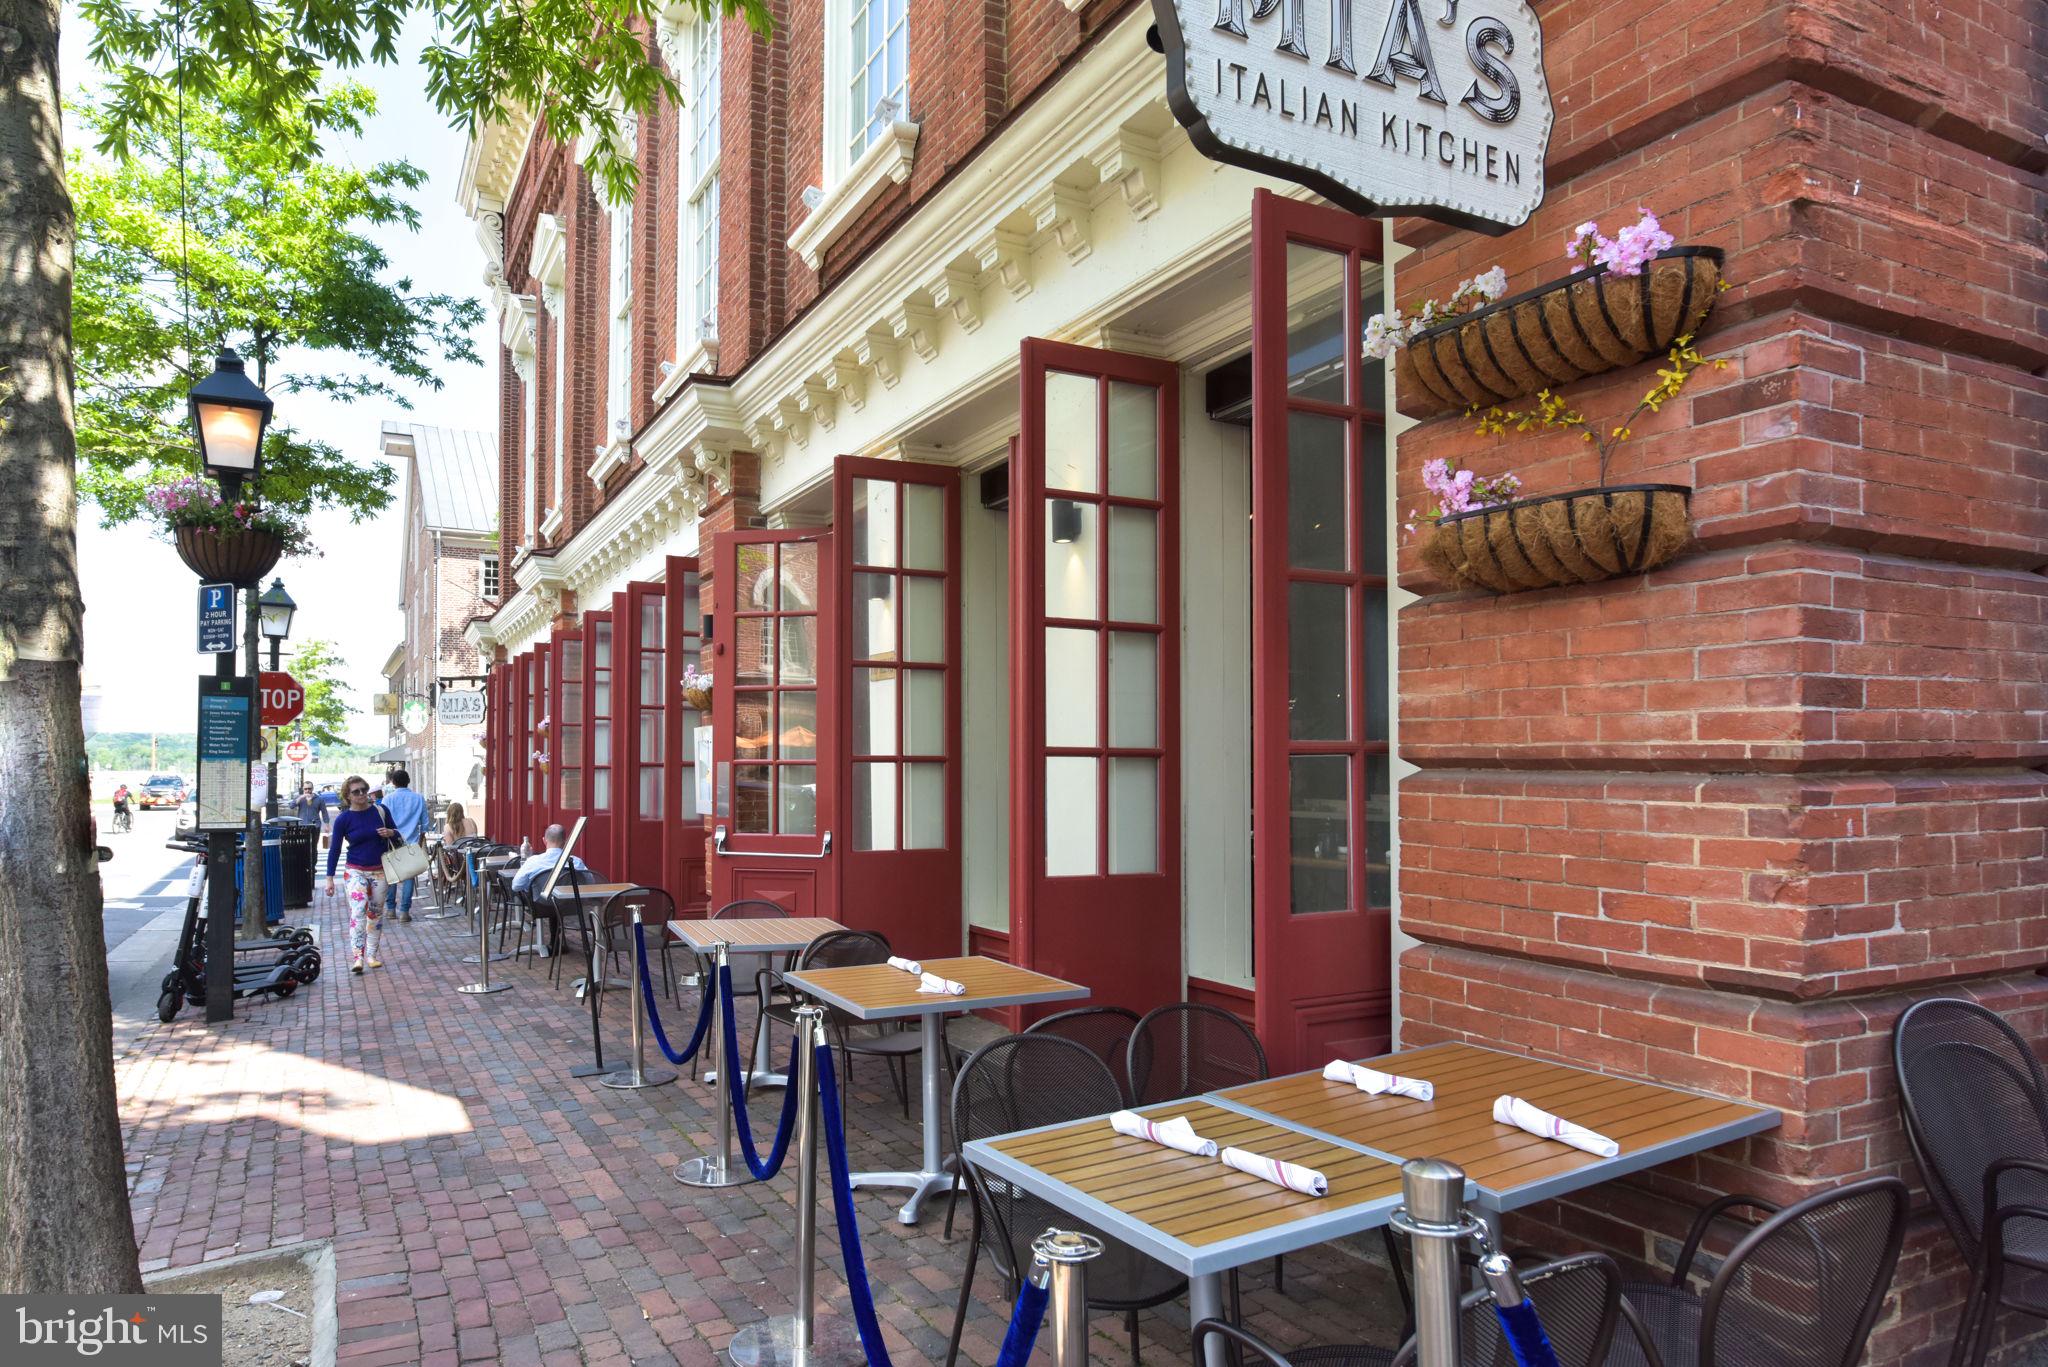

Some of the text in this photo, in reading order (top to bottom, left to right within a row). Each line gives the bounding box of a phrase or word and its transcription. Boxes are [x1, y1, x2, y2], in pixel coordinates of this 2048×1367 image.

[1216, 58, 1521, 185] ITALIAN KITCHEN
[210, 589, 222, 608] P
[205, 610, 227, 619] 2 HOUR
[211, 618, 232, 626] PARKING
[260, 688, 301, 710] TOP
[441, 697, 481, 712] MIA'S
